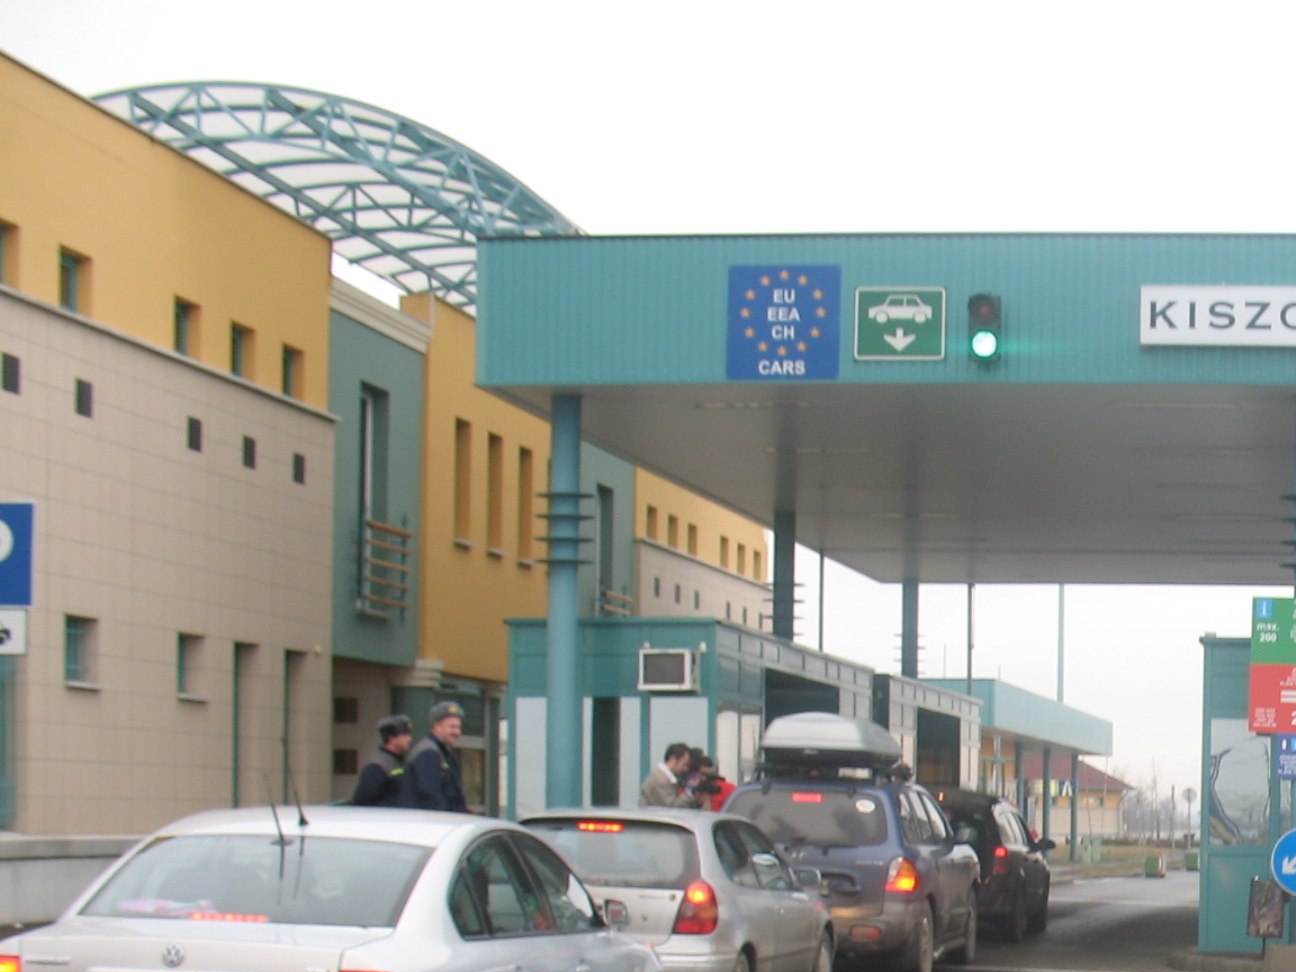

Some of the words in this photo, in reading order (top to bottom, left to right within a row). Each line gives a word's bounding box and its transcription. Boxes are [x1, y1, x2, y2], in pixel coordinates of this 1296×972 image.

[773, 289, 796, 303] EU
[767, 307, 801, 322] EEA
[771, 325, 795, 340] CH
[758, 359, 806, 375] CARS
[1259, 632, 1278, 643] 200
